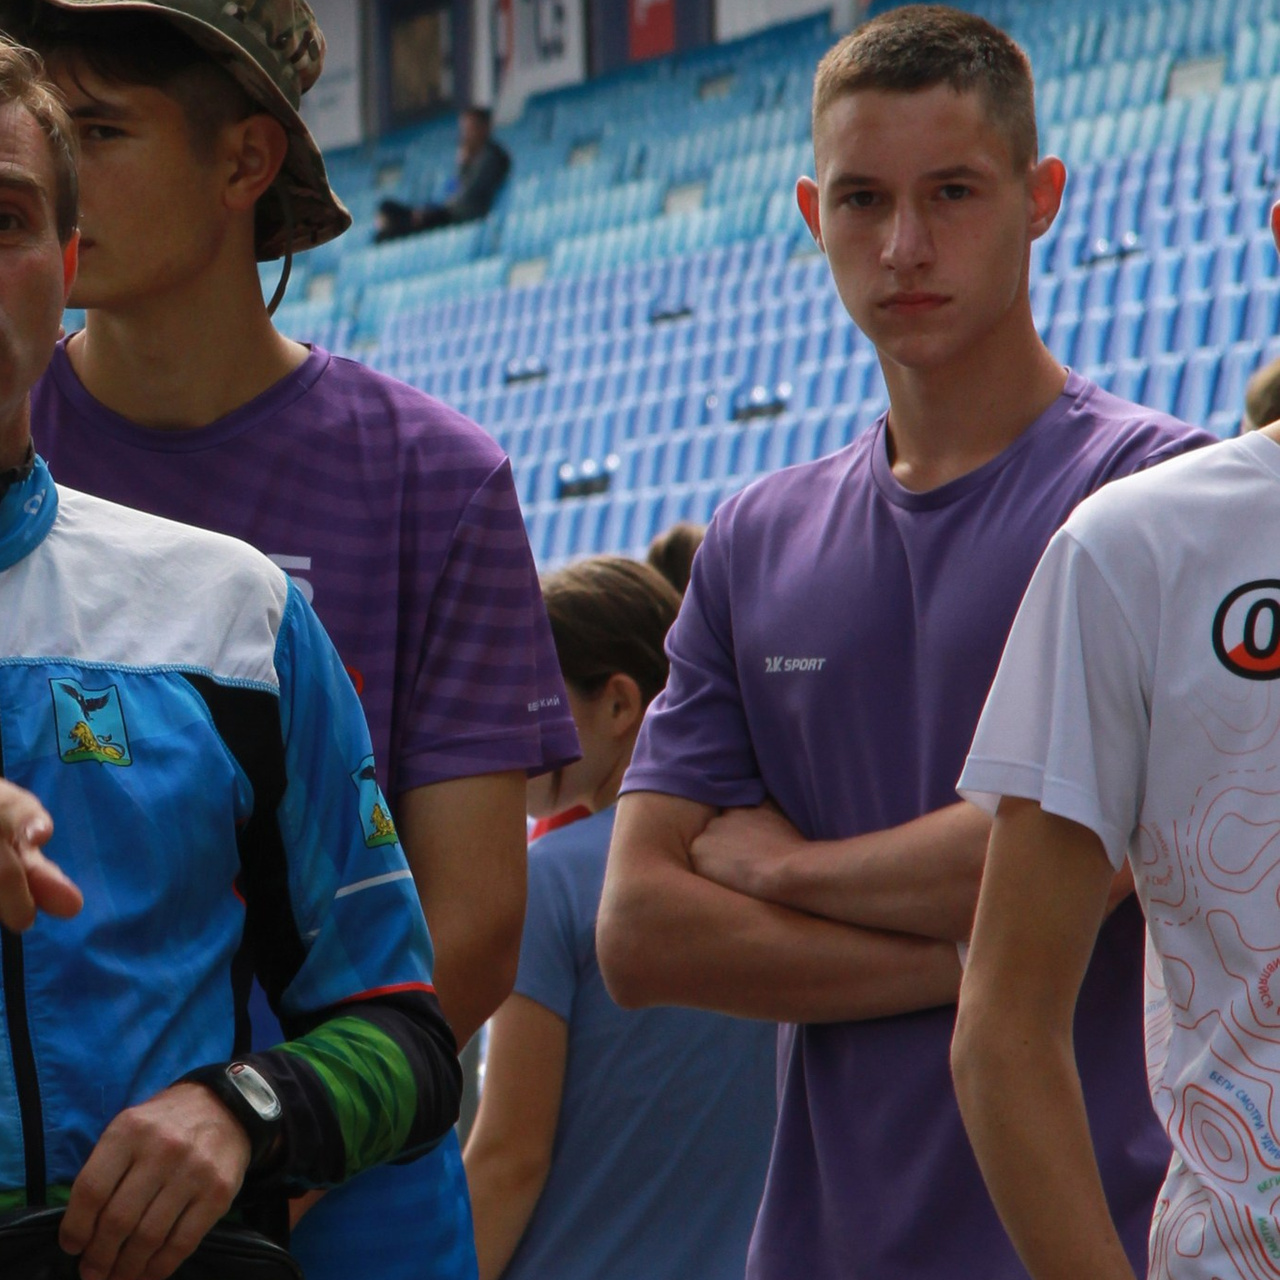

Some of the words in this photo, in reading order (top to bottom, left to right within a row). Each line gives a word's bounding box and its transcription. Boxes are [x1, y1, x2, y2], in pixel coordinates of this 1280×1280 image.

[784, 658, 826, 672] SPORT
[1209, 1070, 1235, 1092] БЕГИ
[1235, 1089, 1265, 1130] СМОТРИ
